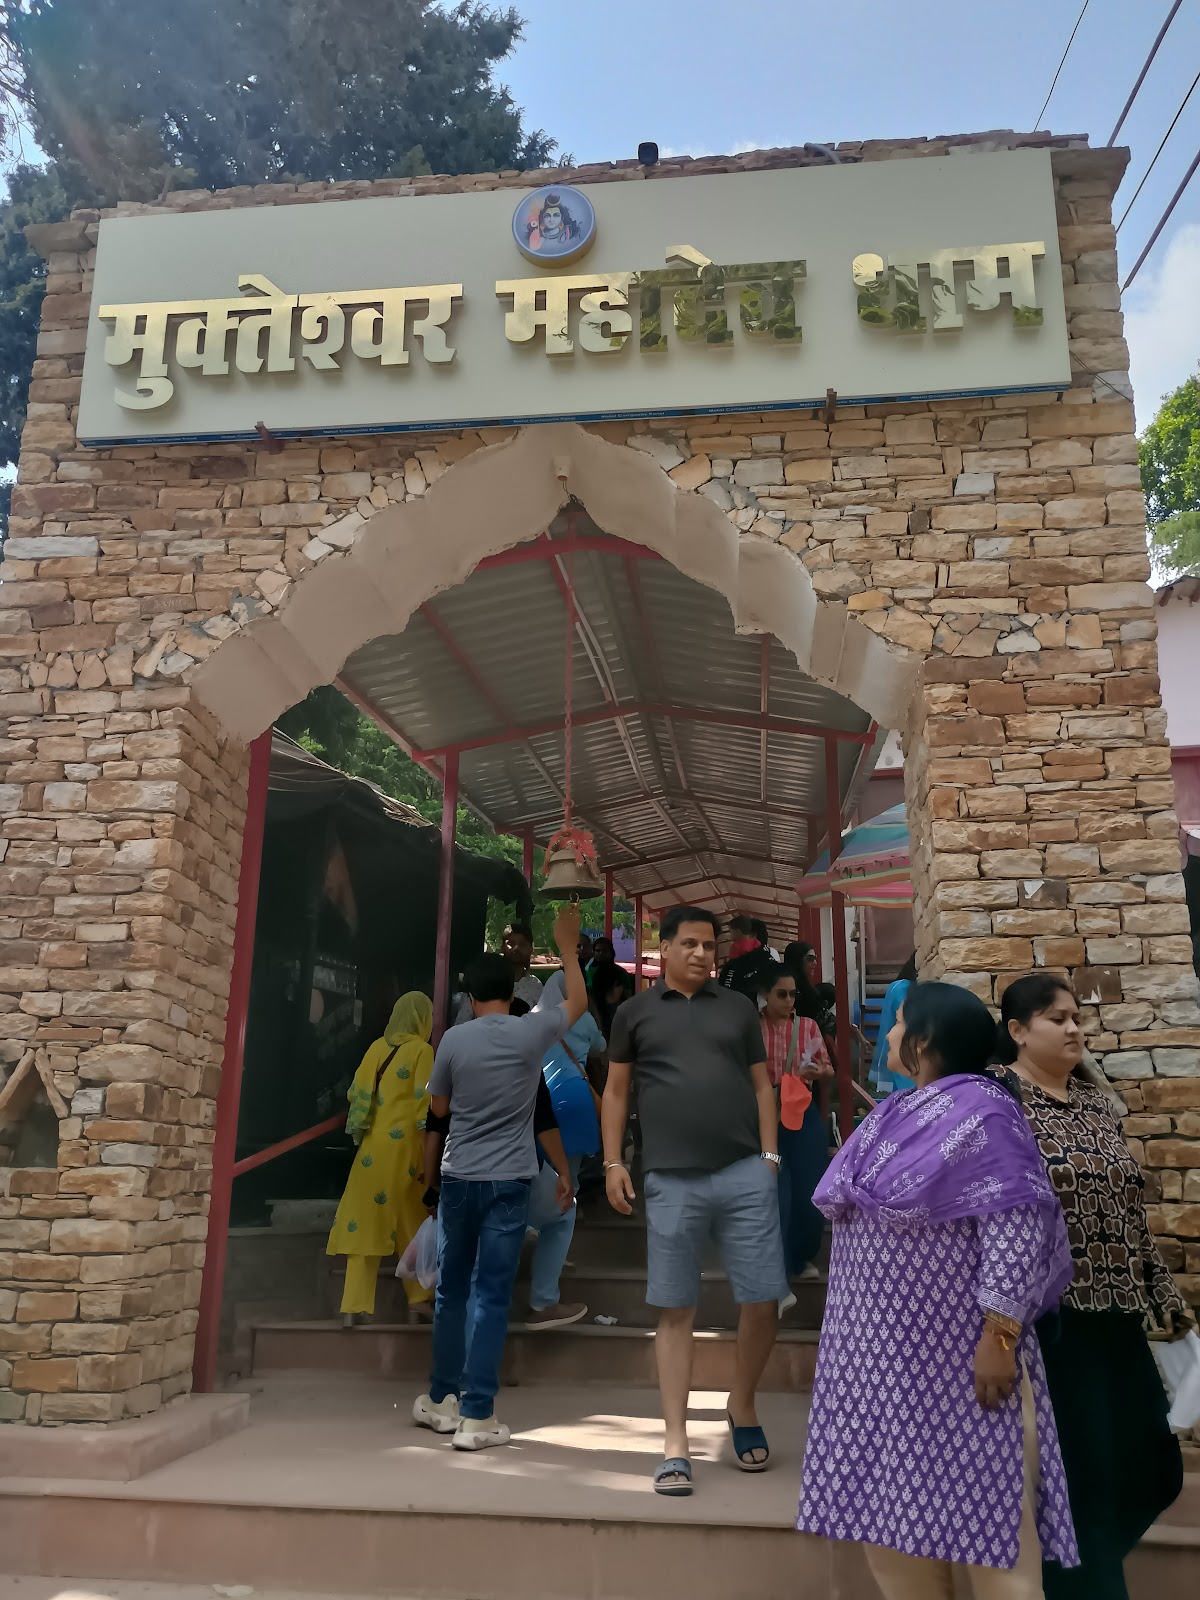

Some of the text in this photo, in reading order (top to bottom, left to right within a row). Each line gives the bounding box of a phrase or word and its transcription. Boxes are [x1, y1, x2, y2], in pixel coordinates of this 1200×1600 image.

[98, 240, 1046, 411] मुक्तेश्वर महादेव धाम
